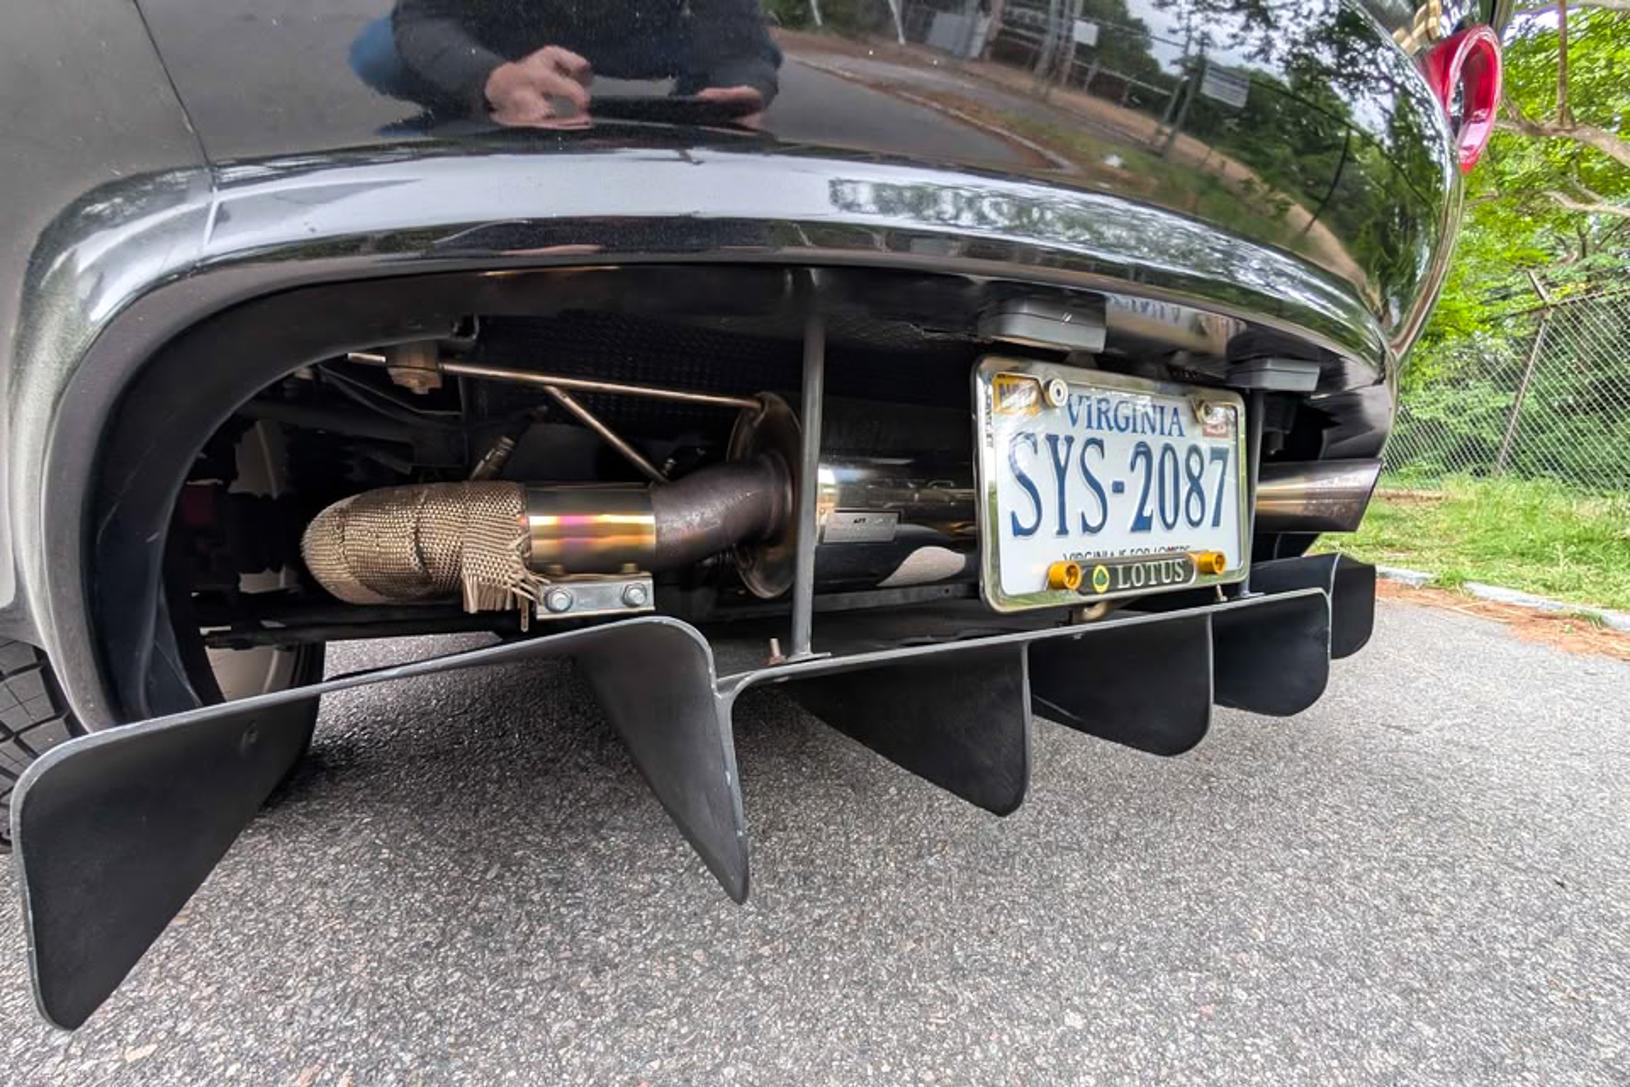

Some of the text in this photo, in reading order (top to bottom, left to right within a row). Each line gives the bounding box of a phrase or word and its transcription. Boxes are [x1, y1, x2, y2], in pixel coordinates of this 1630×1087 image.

[1067, 393, 1185, 437] VIRGINIA
[1008, 431, 1230, 537] SYS-2087
[1117, 558, 1185, 589] LOTUS
